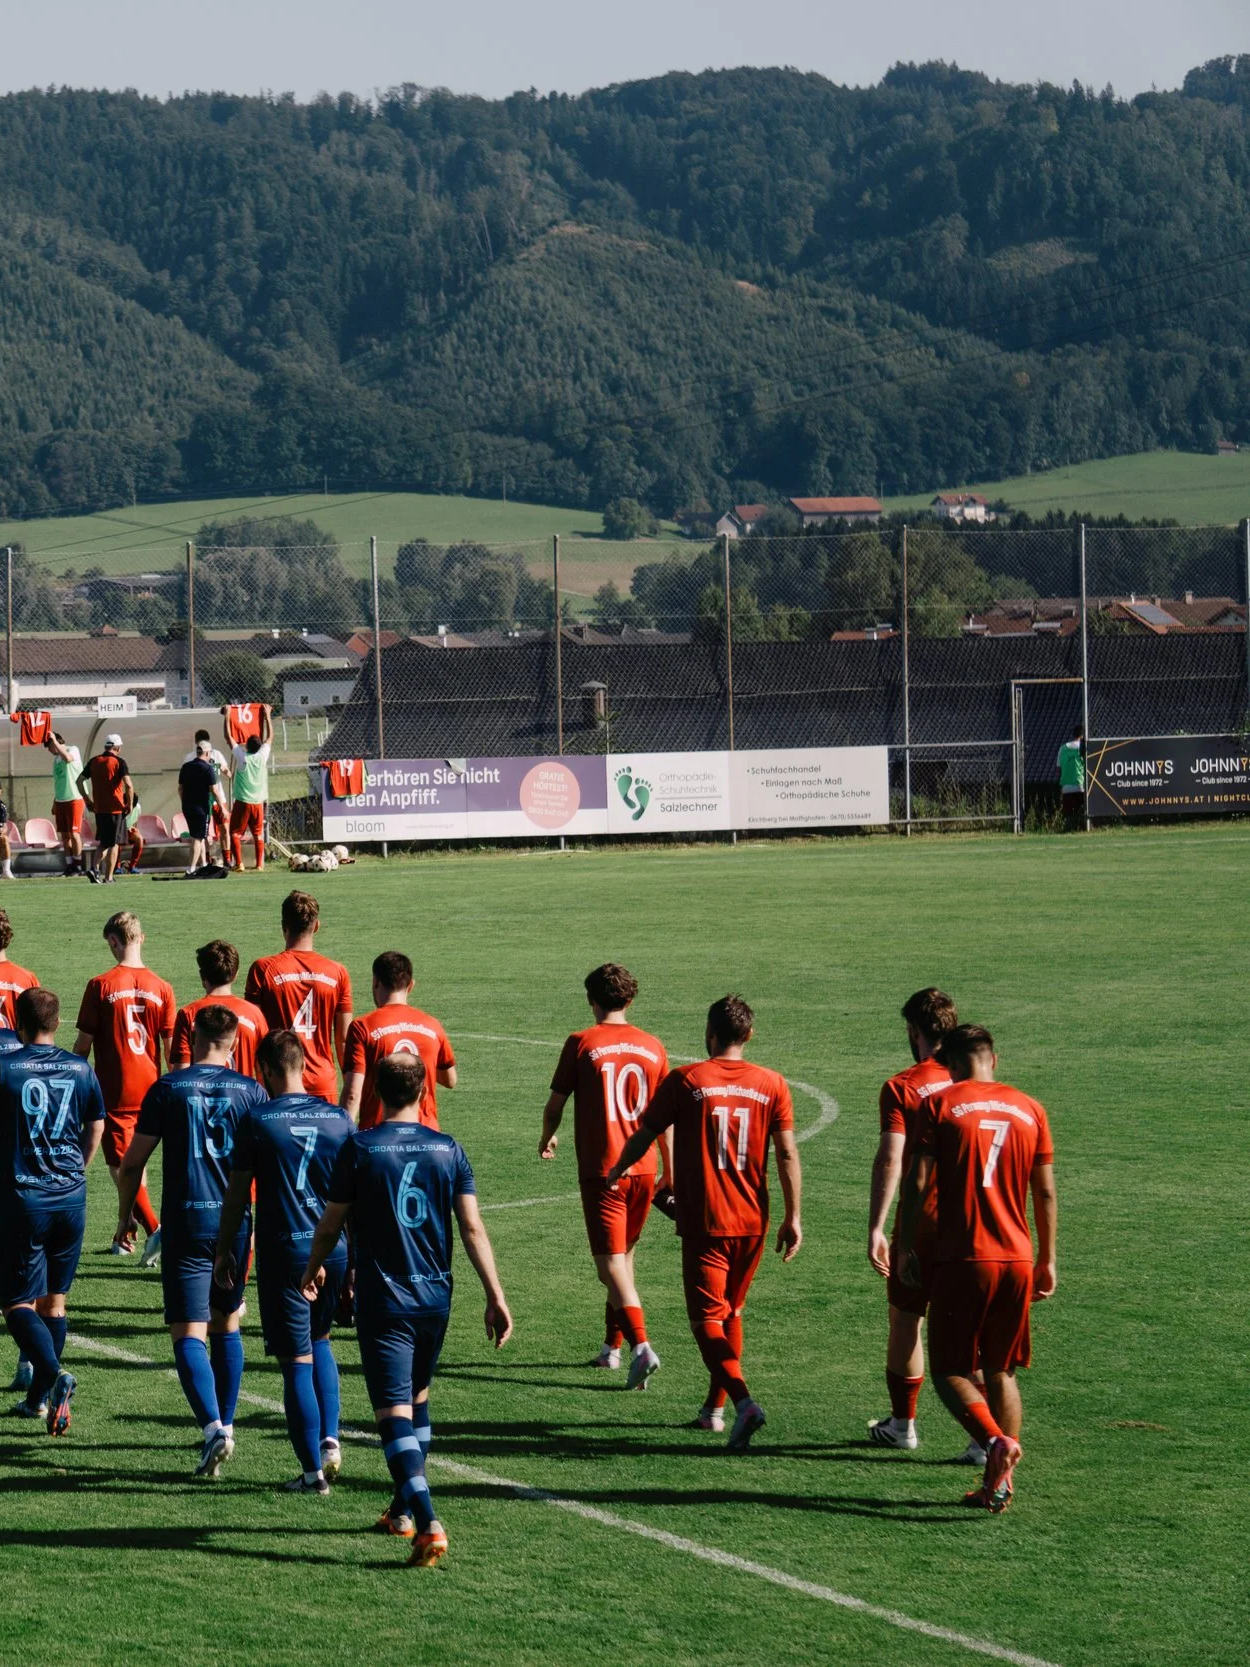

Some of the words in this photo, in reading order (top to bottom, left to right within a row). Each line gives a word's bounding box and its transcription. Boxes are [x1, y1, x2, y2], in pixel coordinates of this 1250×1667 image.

[100, 703, 124, 712] HEIM
[237, 703, 253, 724] 16
[338, 759, 354, 777] 19
[751, 764, 821, 774] Schuhfachhandel
[1105, 760, 1174, 777] JOHNNYS
[1190, 757, 1250, 774] JOHNNY
[367, 768, 430, 787] erhören
[433, 768, 456, 785] Sie
[460, 766, 500, 784] nicht
[765, 778, 800, 788] Einlagen
[802, 778, 822, 786] nach
[824, 777, 842, 786] Maß
[1117, 780, 1131, 788] Club
[1150, 778, 1162, 786] 1972
[1202, 776, 1216, 784] Club
[1216, 776, 1232, 784] since
[1234, 775, 1247, 784] 1972
[659, 784, 718, 794] Schuhtechnik
[779, 790, 840, 801] Orthopädische
[842, 789, 871, 798] Schuhe
[380, 788, 440, 810] Anpfiff.
[1122, 796, 1204, 806] WWW.JOHNNYS.AT
[660, 802, 718, 812] Salzlechner
[345, 819, 386, 833] bloom
[294, 988, 317, 1040] 4
[126, 1005, 148, 1056] 5
[10, 1062, 43, 1070] CROATIA
[44, 1063, 82, 1072] SALZBURG
[172, 1080, 204, 1089] CROATIA
[205, 1081, 247, 1090] SALZBURG
[601, 1062, 648, 1122] 10
[22, 1078, 76, 1140] 97
[262, 1112, 298, 1120] CROATIA
[951, 1105, 964, 1118] SG
[187, 1096, 234, 1159] 13
[712, 1106, 750, 1171] 11
[368, 1144, 404, 1154] CROATIA
[406, 1144, 450, 1152] SALZBURG
[978, 1120, 1011, 1188] 7
[290, 1126, 318, 1190] 7
[397, 1162, 428, 1228] 6
